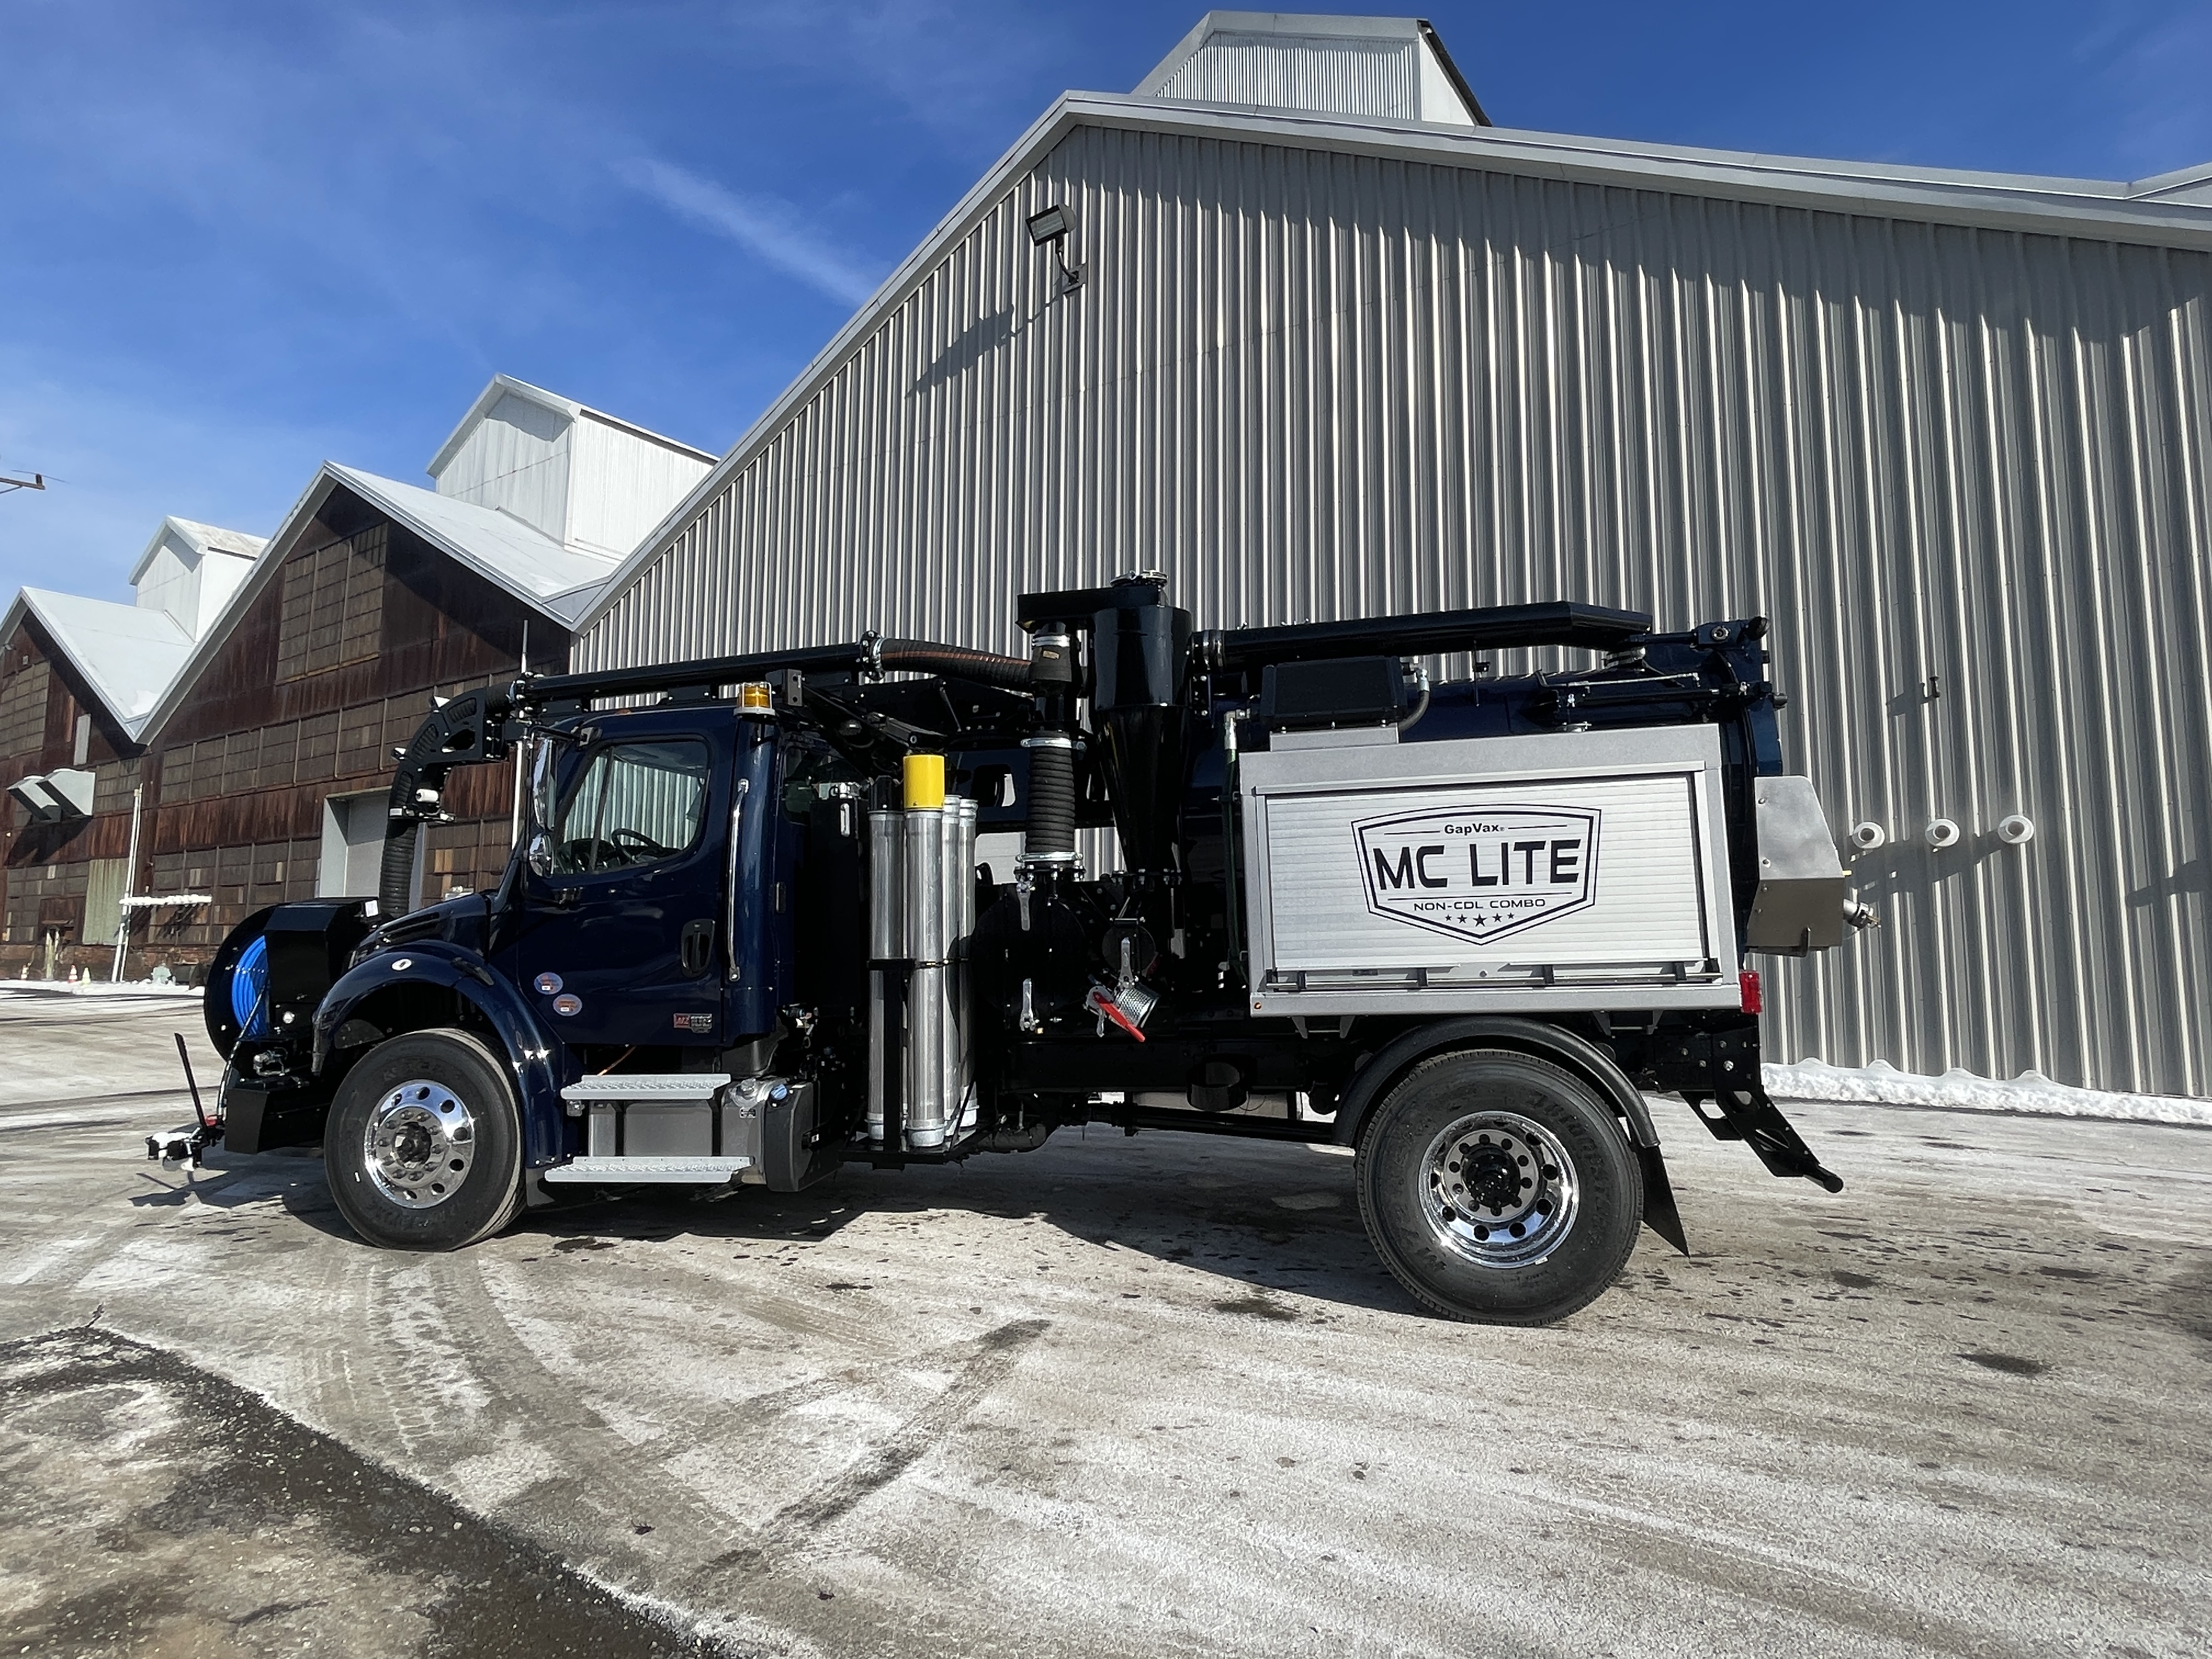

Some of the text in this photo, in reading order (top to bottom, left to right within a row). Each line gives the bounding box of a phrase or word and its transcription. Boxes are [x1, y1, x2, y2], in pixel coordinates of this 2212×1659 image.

[1373, 839, 1581, 890] MC LITE
[1413, 899, 1546, 911] NON-CDL COMBO
